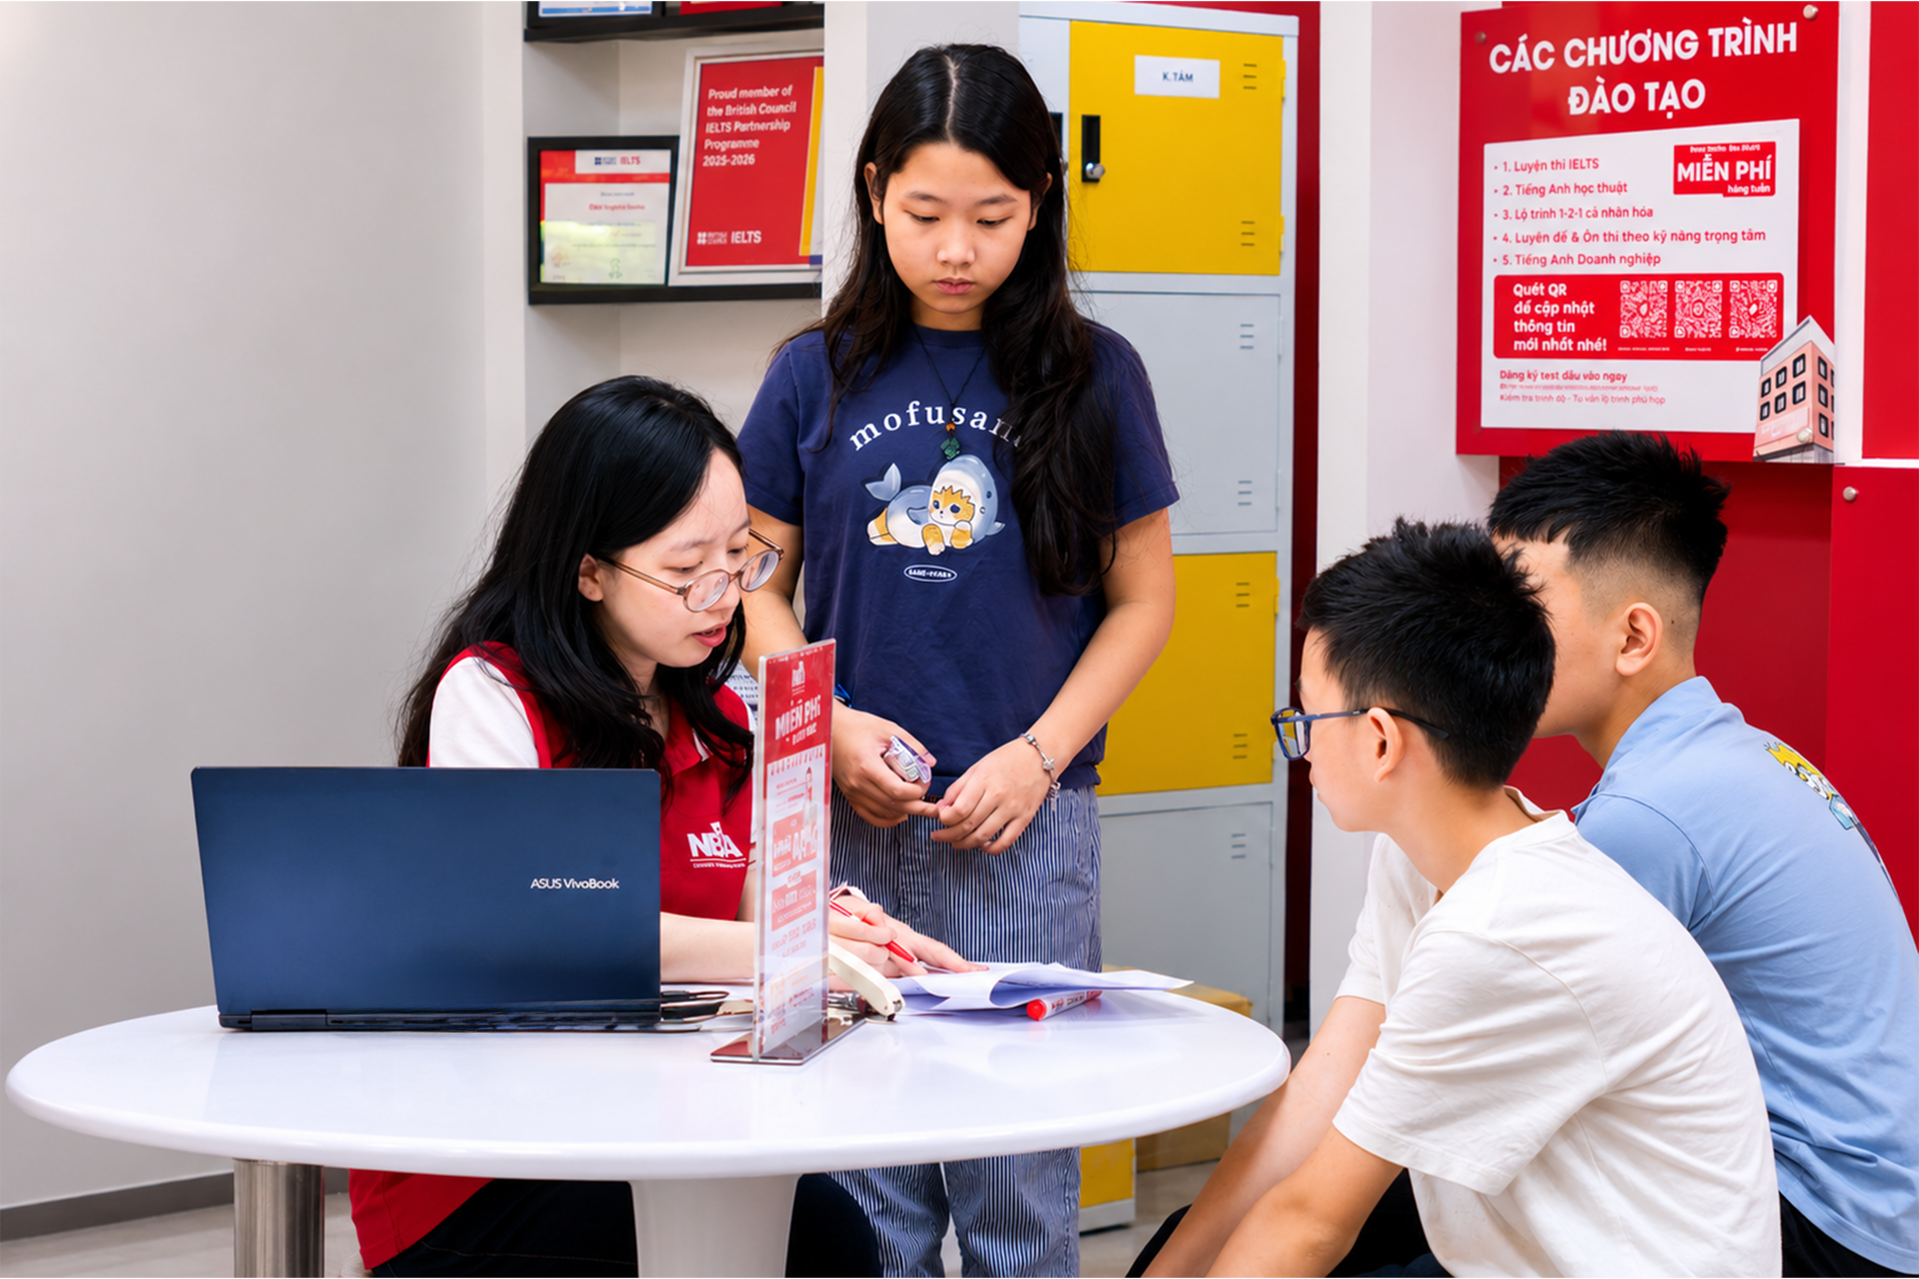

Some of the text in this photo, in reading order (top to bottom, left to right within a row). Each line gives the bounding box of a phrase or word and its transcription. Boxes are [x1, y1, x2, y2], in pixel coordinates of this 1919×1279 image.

[1490, 17, 1797, 73] CÁC CHƯƠNG TRÌNH
[708, 84, 793, 100] Proud member of
[1568, 76, 1706, 119] ĐÀO TẠO
[707, 102, 796, 117] the British Council
[706, 119, 790, 133] IELTS Partnership
[704, 138, 760, 152] Programme
[702, 154, 755, 166] 2025-2026
[1502, 158, 1599, 174] 1. Luyện thi IELTS
[1678, 154, 1772, 182] MIỄN PHÍ
[1502, 185, 1512, 196] 2.
[1516, 183, 1546, 198] Tiếng
[1549, 183, 1571, 194] Anh
[1574, 183, 1594, 197] học
[1502, 210, 1512, 220] 3.
[1559, 208, 1583, 219] 1-2-1
[731, 231, 761, 244] IELTS
[1502, 233, 1512, 243] 4.
[1571, 232, 1579, 243] &
[1603, 230, 1619, 242] thi
[1622, 230, 1649, 242] theo
[1704, 230, 1738, 244] trọng
[1502, 253, 1661, 267] 5. Tiếng Anh Doanh nghiệp
[1513, 282, 1567, 298] Quét QR
[1534, 300, 1560, 317] cập
[1563, 300, 1595, 318] nhật
[1557, 319, 1575, 332] tin
[1577, 337, 1607, 351] nhé!
[1540, 371, 1559, 380] test
[1603, 372, 1627, 383] ngay
[849, 400, 1022, 451] mofusan
[687, 822, 743, 858] NBA
[530, 878, 619, 889] ASUS VivoBook
